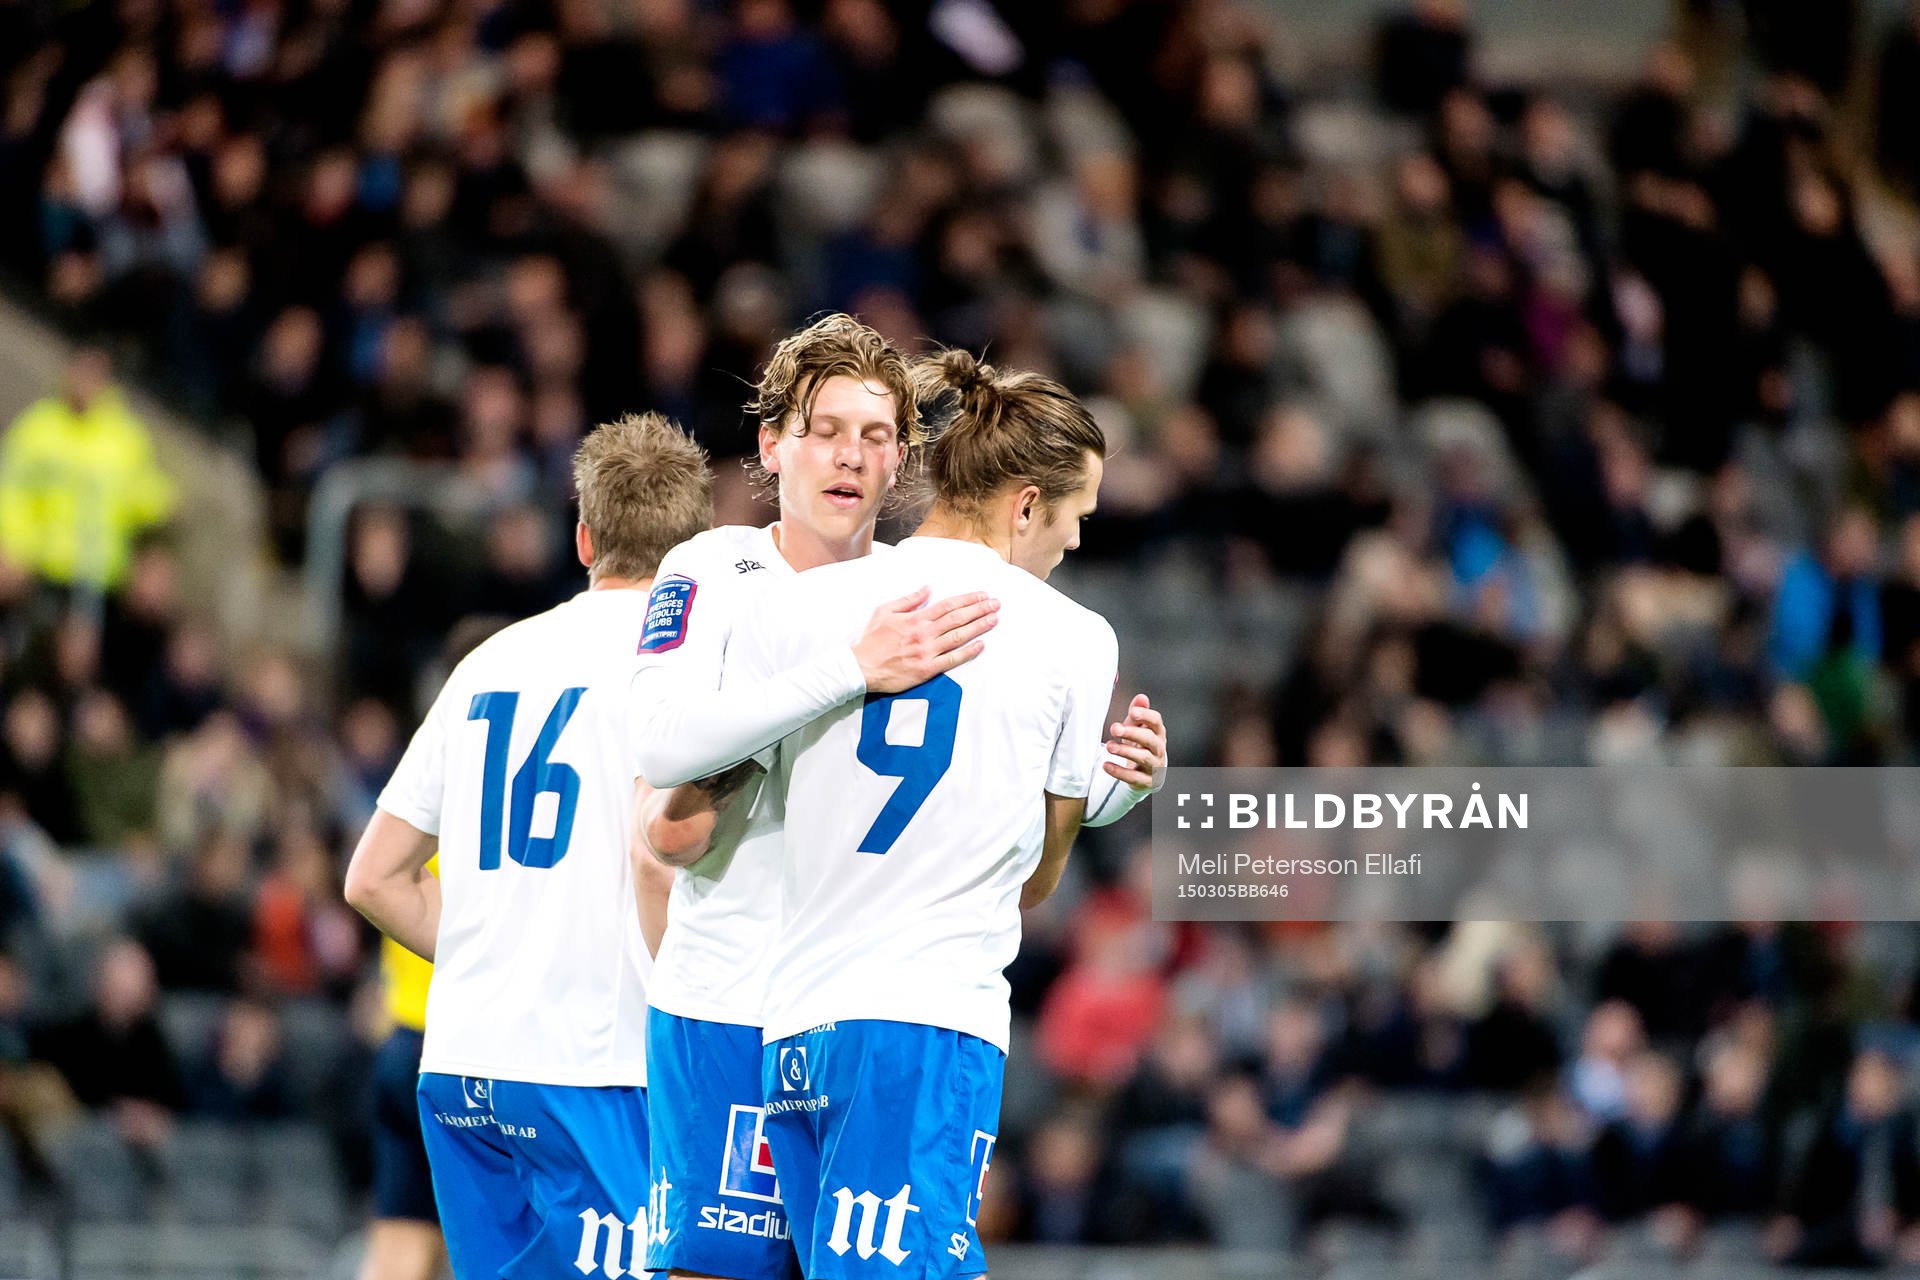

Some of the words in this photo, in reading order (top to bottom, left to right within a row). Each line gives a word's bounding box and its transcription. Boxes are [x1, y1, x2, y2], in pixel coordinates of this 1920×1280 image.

[467, 687, 590, 870] 16
[856, 673, 963, 855] 9
[697, 1203, 791, 1241] stadiu
[827, 1184, 921, 1266] nt
